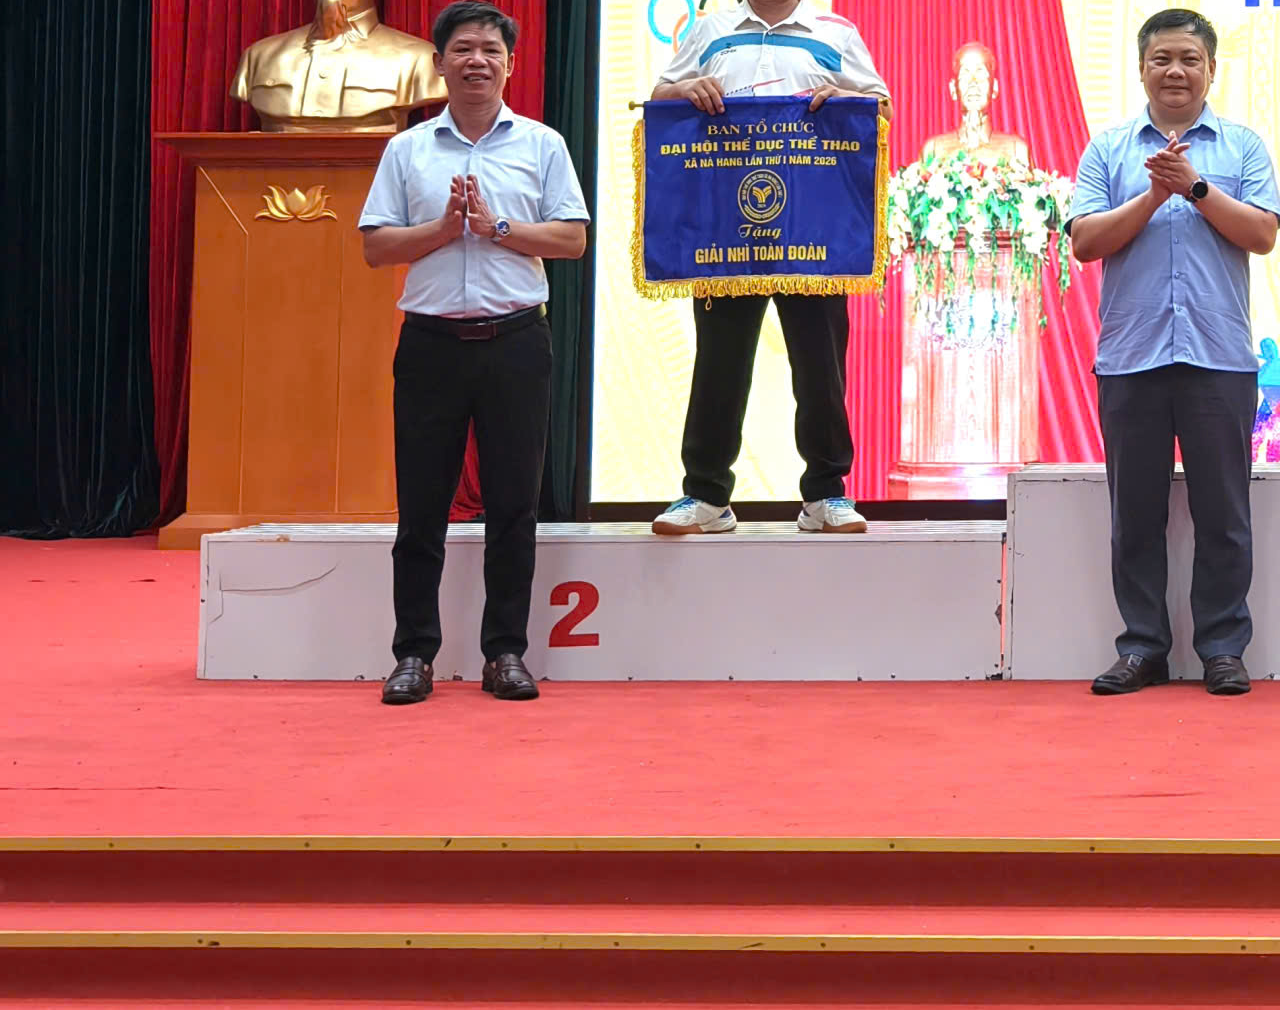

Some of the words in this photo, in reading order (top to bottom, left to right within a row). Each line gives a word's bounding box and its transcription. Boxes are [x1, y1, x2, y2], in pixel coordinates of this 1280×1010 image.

[708, 125, 740, 134] BAN
[745, 118, 767, 134] TỔ
[773, 120, 814, 133] CHỨC
[661, 144, 686, 155] ĐẠI
[692, 140, 718, 153] HỘI
[724, 137, 751, 151] THỂ
[756, 139, 784, 152] DỤC
[789, 136, 818, 149] THỂ
[821, 140, 860, 151] THAO
[717, 157, 742, 166] HANG
[814, 156, 837, 165] 2026
[738, 224, 781, 240] Tặng
[695, 243, 723, 263] GIẢI
[728, 243, 749, 262] NHÌ
[753, 243, 784, 261] TOÀN
[788, 242, 826, 260] ĐOÀN
[548, 580, 600, 648] 2
